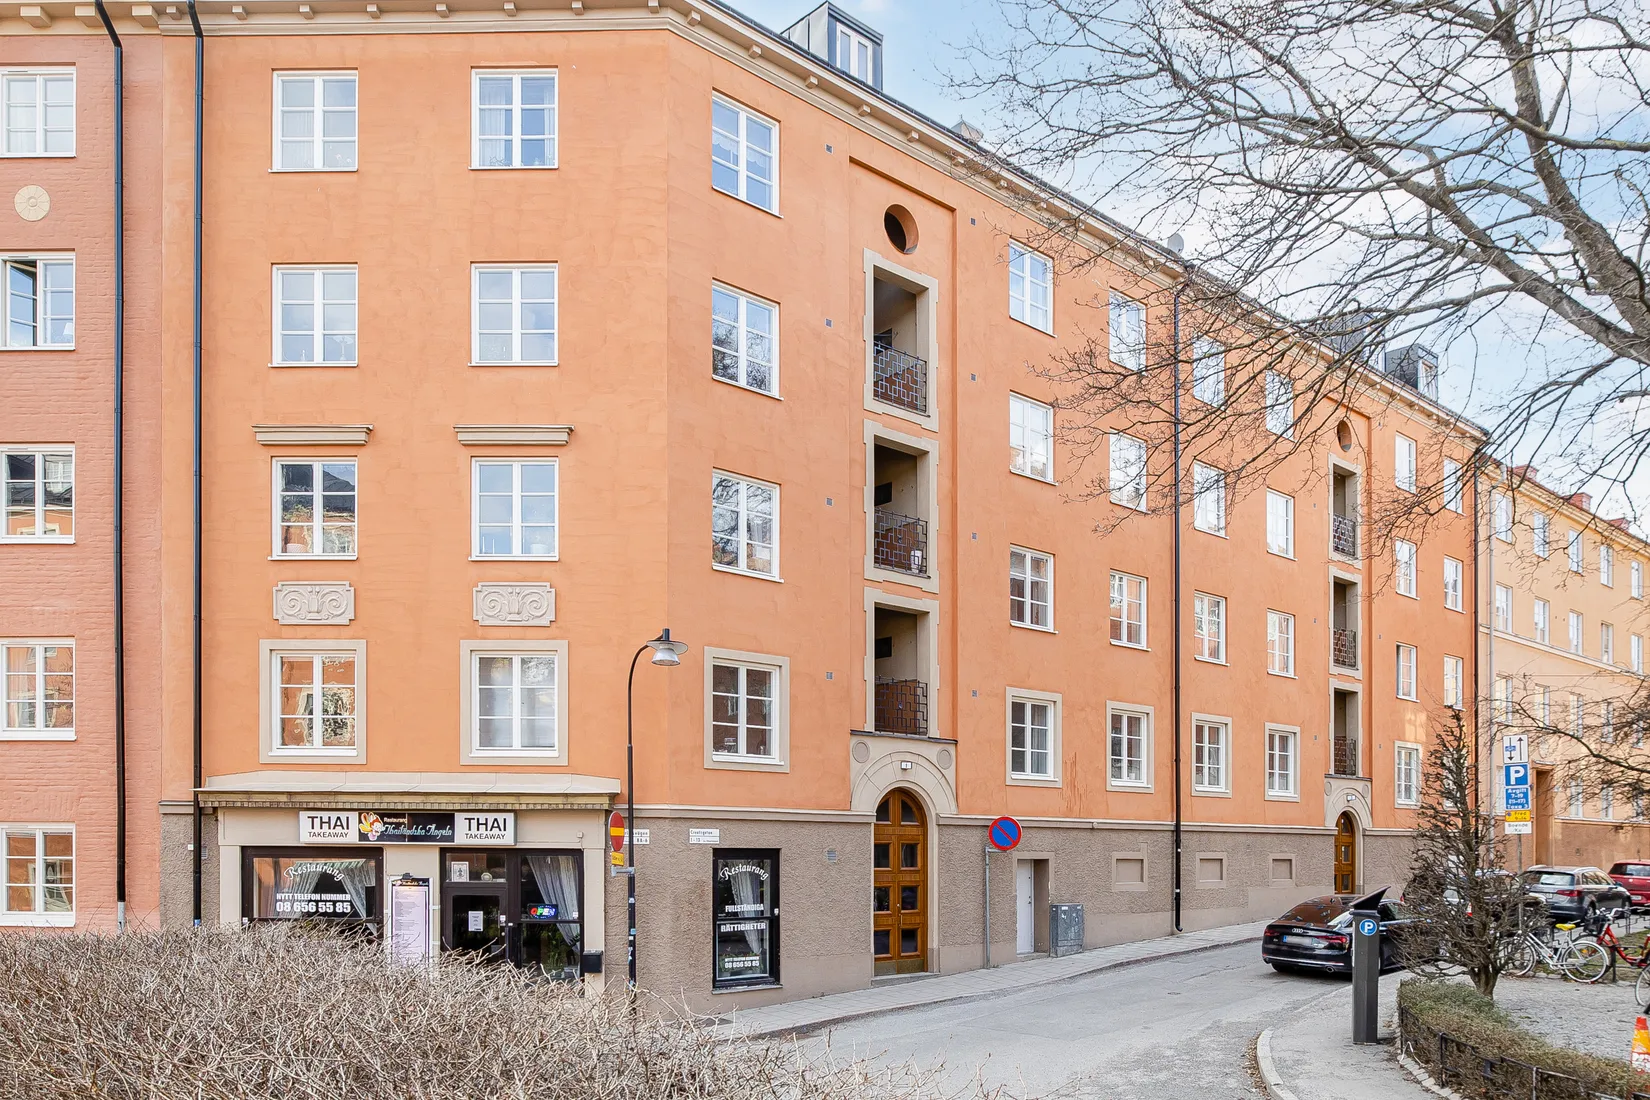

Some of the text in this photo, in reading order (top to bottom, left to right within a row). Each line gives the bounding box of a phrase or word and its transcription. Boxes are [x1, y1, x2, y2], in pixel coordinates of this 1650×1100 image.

[1509, 766, 1525, 785] P
[307, 816, 349, 830] THAI
[464, 817, 507, 832] THAI
[283, 863, 345, 881] Restaurang
[720, 863, 769, 880] Restaurang
[276, 901, 351, 913] 08 656 55 85
[530, 907, 556, 916] OPEN
[725, 903, 764, 913] FULLSTÄNDIGA
[720, 922, 766, 932] RÄTTIGHETER
